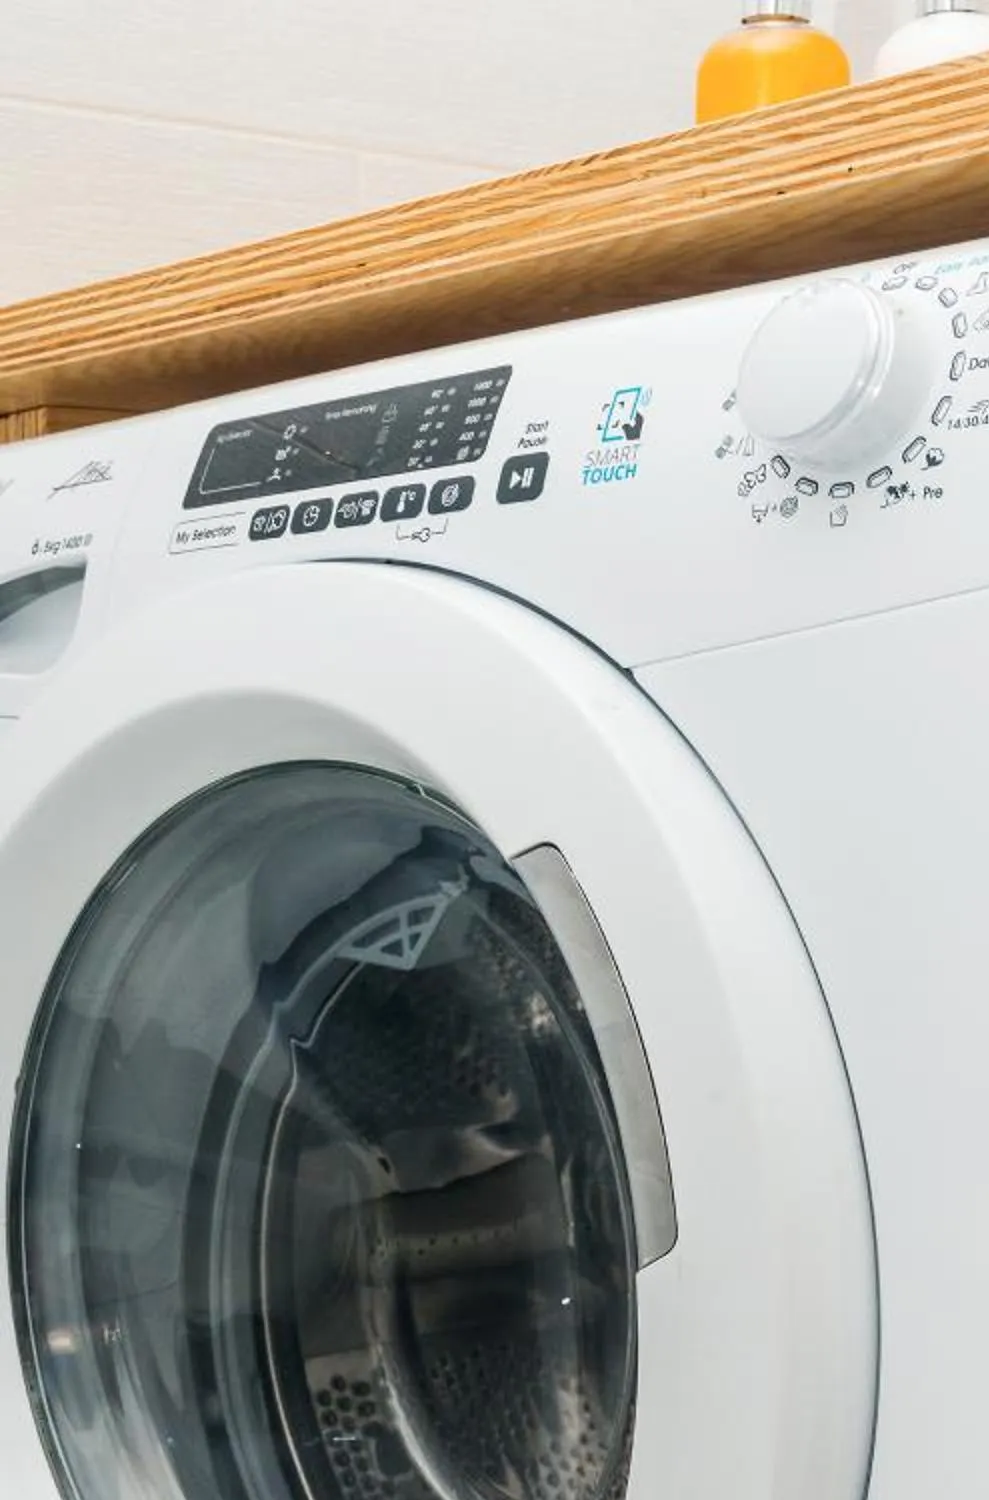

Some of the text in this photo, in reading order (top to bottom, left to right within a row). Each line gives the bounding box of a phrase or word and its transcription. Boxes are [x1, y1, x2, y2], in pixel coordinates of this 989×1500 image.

[585, 443, 641, 468] SMART
[581, 463, 638, 486] TOUCH
[922, 485, 944, 498] Pre
[175, 524, 237, 545] My Selection
